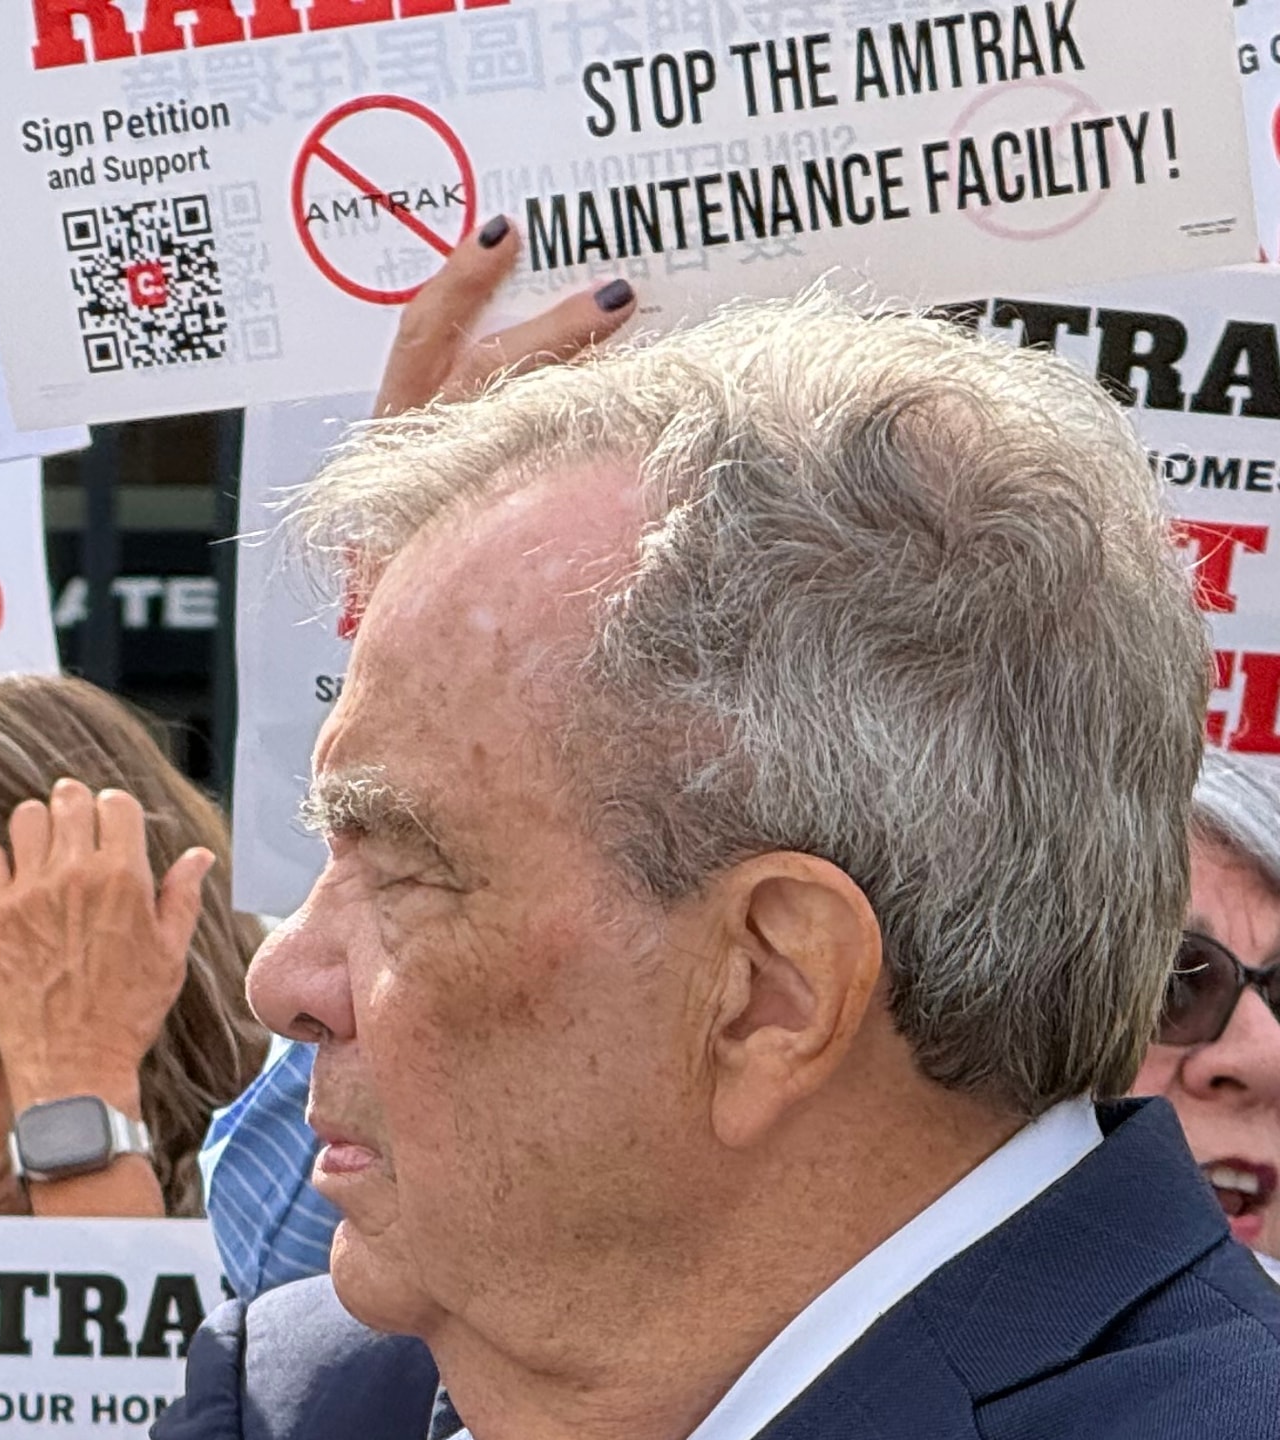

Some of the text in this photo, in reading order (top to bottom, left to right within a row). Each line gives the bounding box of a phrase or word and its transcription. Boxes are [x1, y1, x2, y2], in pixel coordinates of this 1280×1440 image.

[582, 49, 716, 138] STOP
[729, 31, 838, 116] THE
[855, 0, 1085, 102] AMTRAK
[22, 98, 231, 156] Sign Petition
[48, 145, 211, 190] and Support
[526, 107, 1180, 272] MAINTENANCE FACILITY!
[304, 183, 468, 226] AMTRAK
